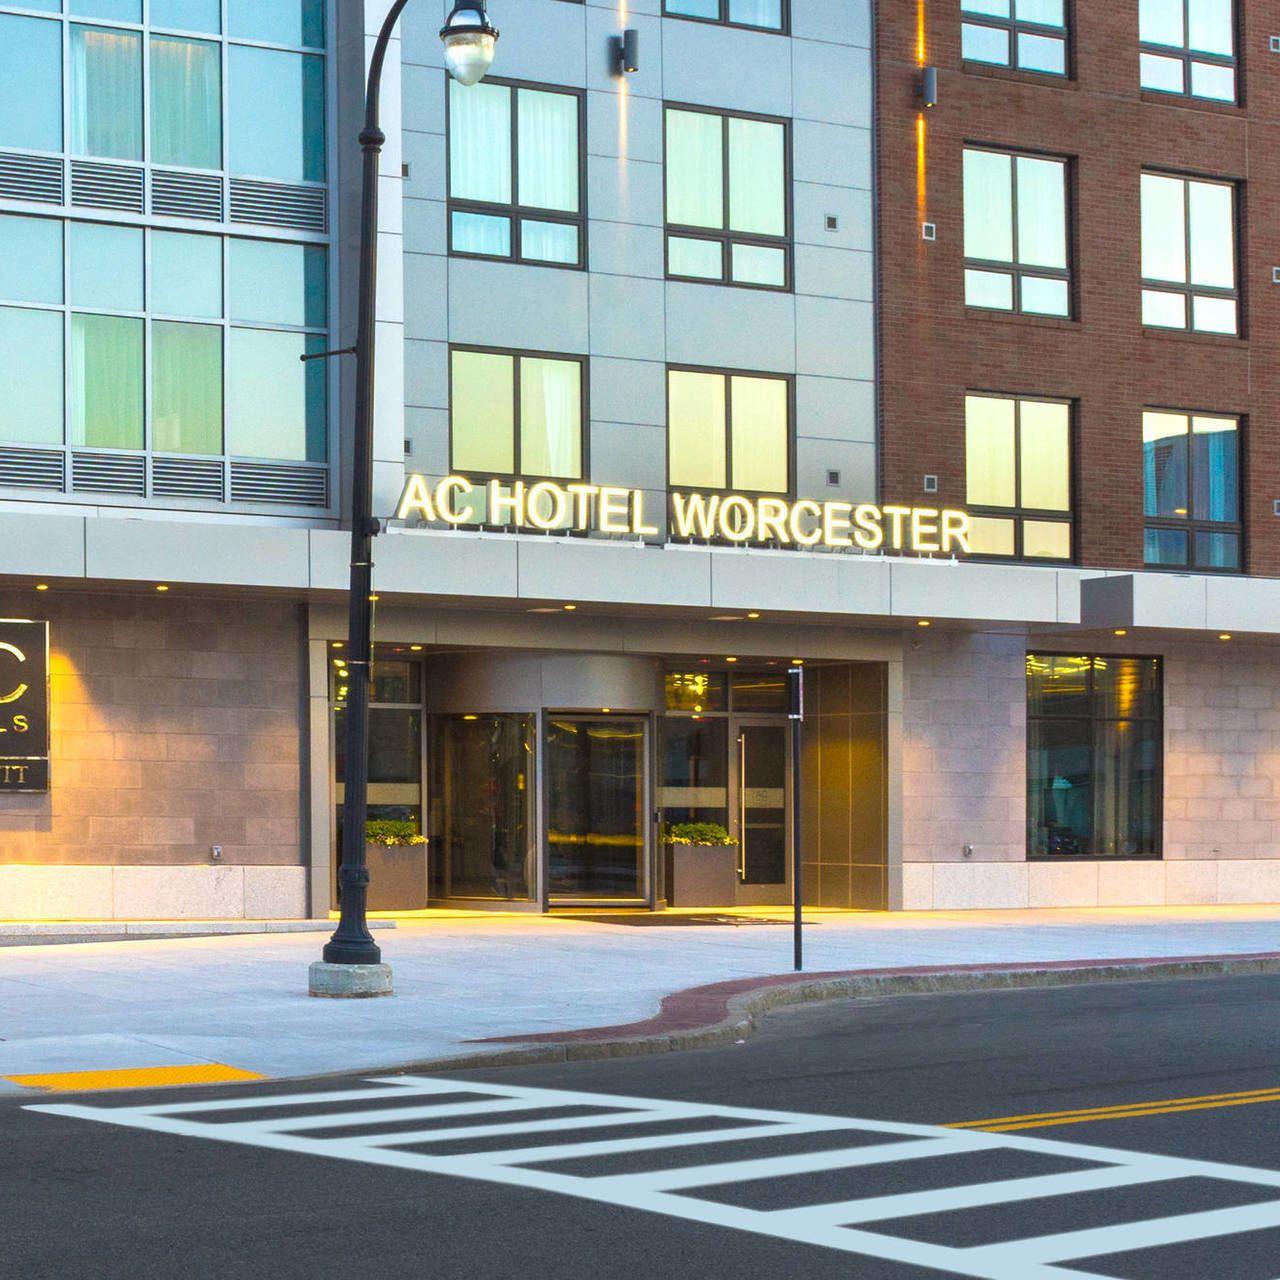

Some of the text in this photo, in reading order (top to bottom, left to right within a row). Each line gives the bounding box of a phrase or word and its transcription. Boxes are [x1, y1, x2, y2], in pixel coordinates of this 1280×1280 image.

[398, 473, 972, 554] AC HOTEL WORCESTER
